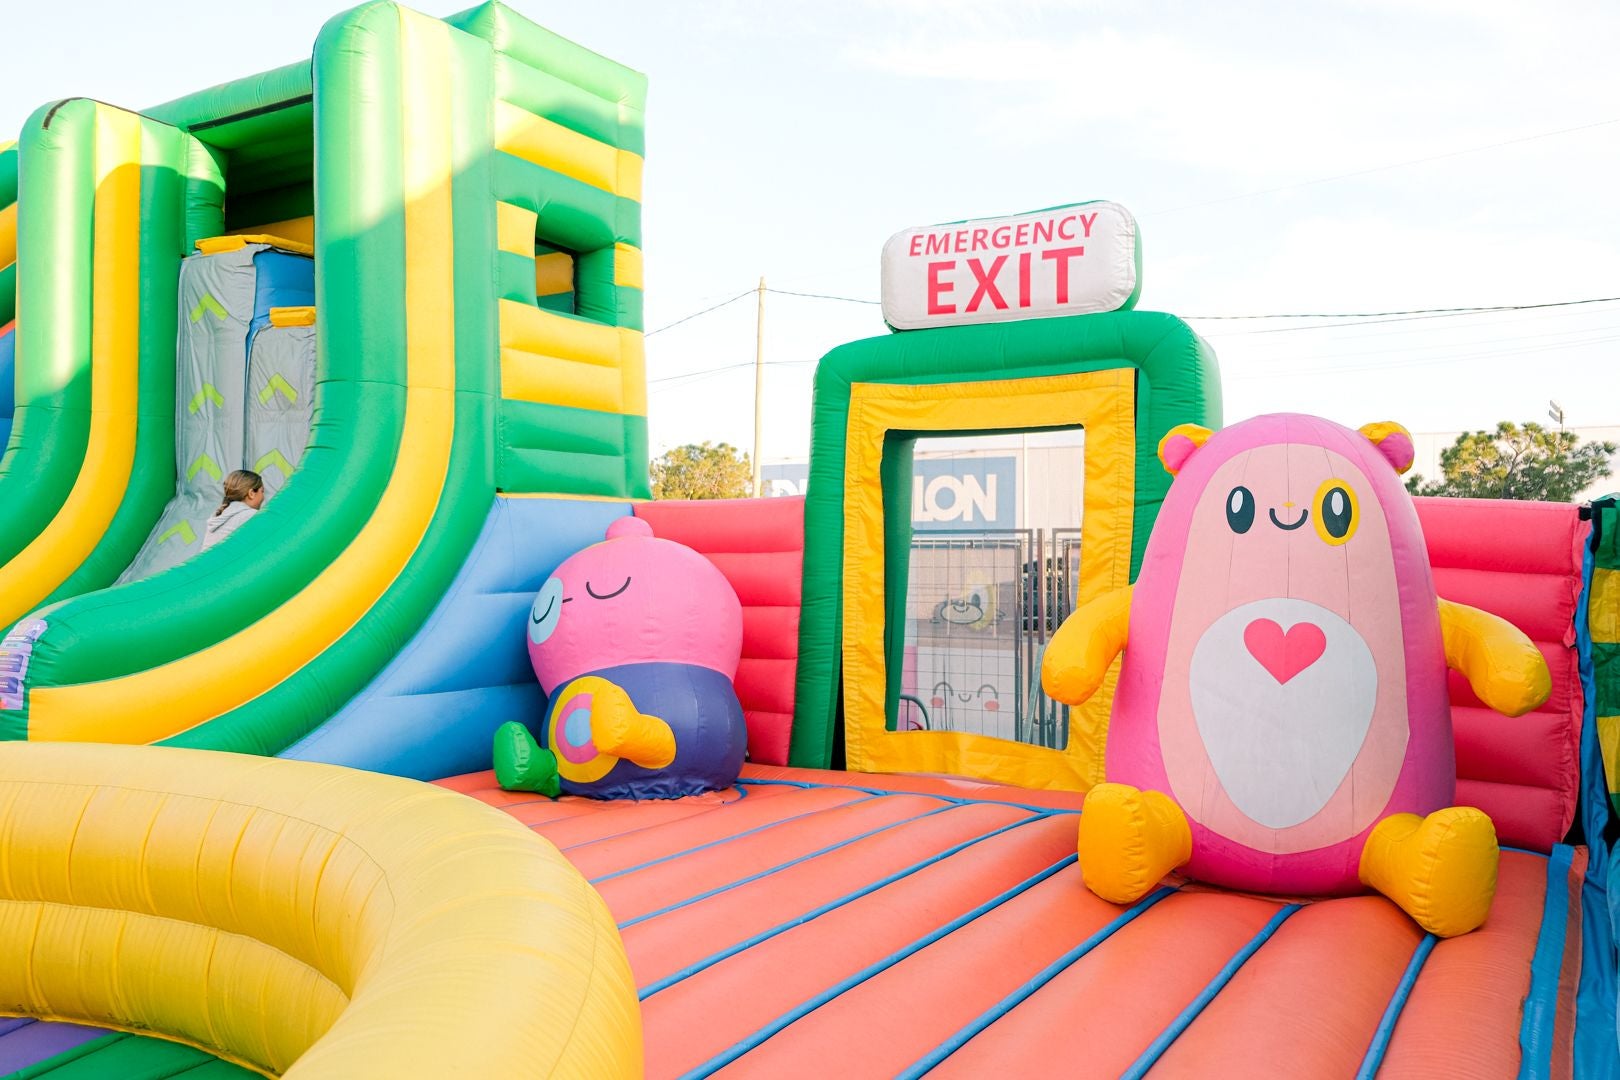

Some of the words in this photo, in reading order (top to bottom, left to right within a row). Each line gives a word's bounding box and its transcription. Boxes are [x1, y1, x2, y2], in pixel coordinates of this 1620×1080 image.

[909, 212, 1098, 257] EMERGENCY
[927, 246, 1085, 315] EXIT
[912, 473, 998, 522] LON
